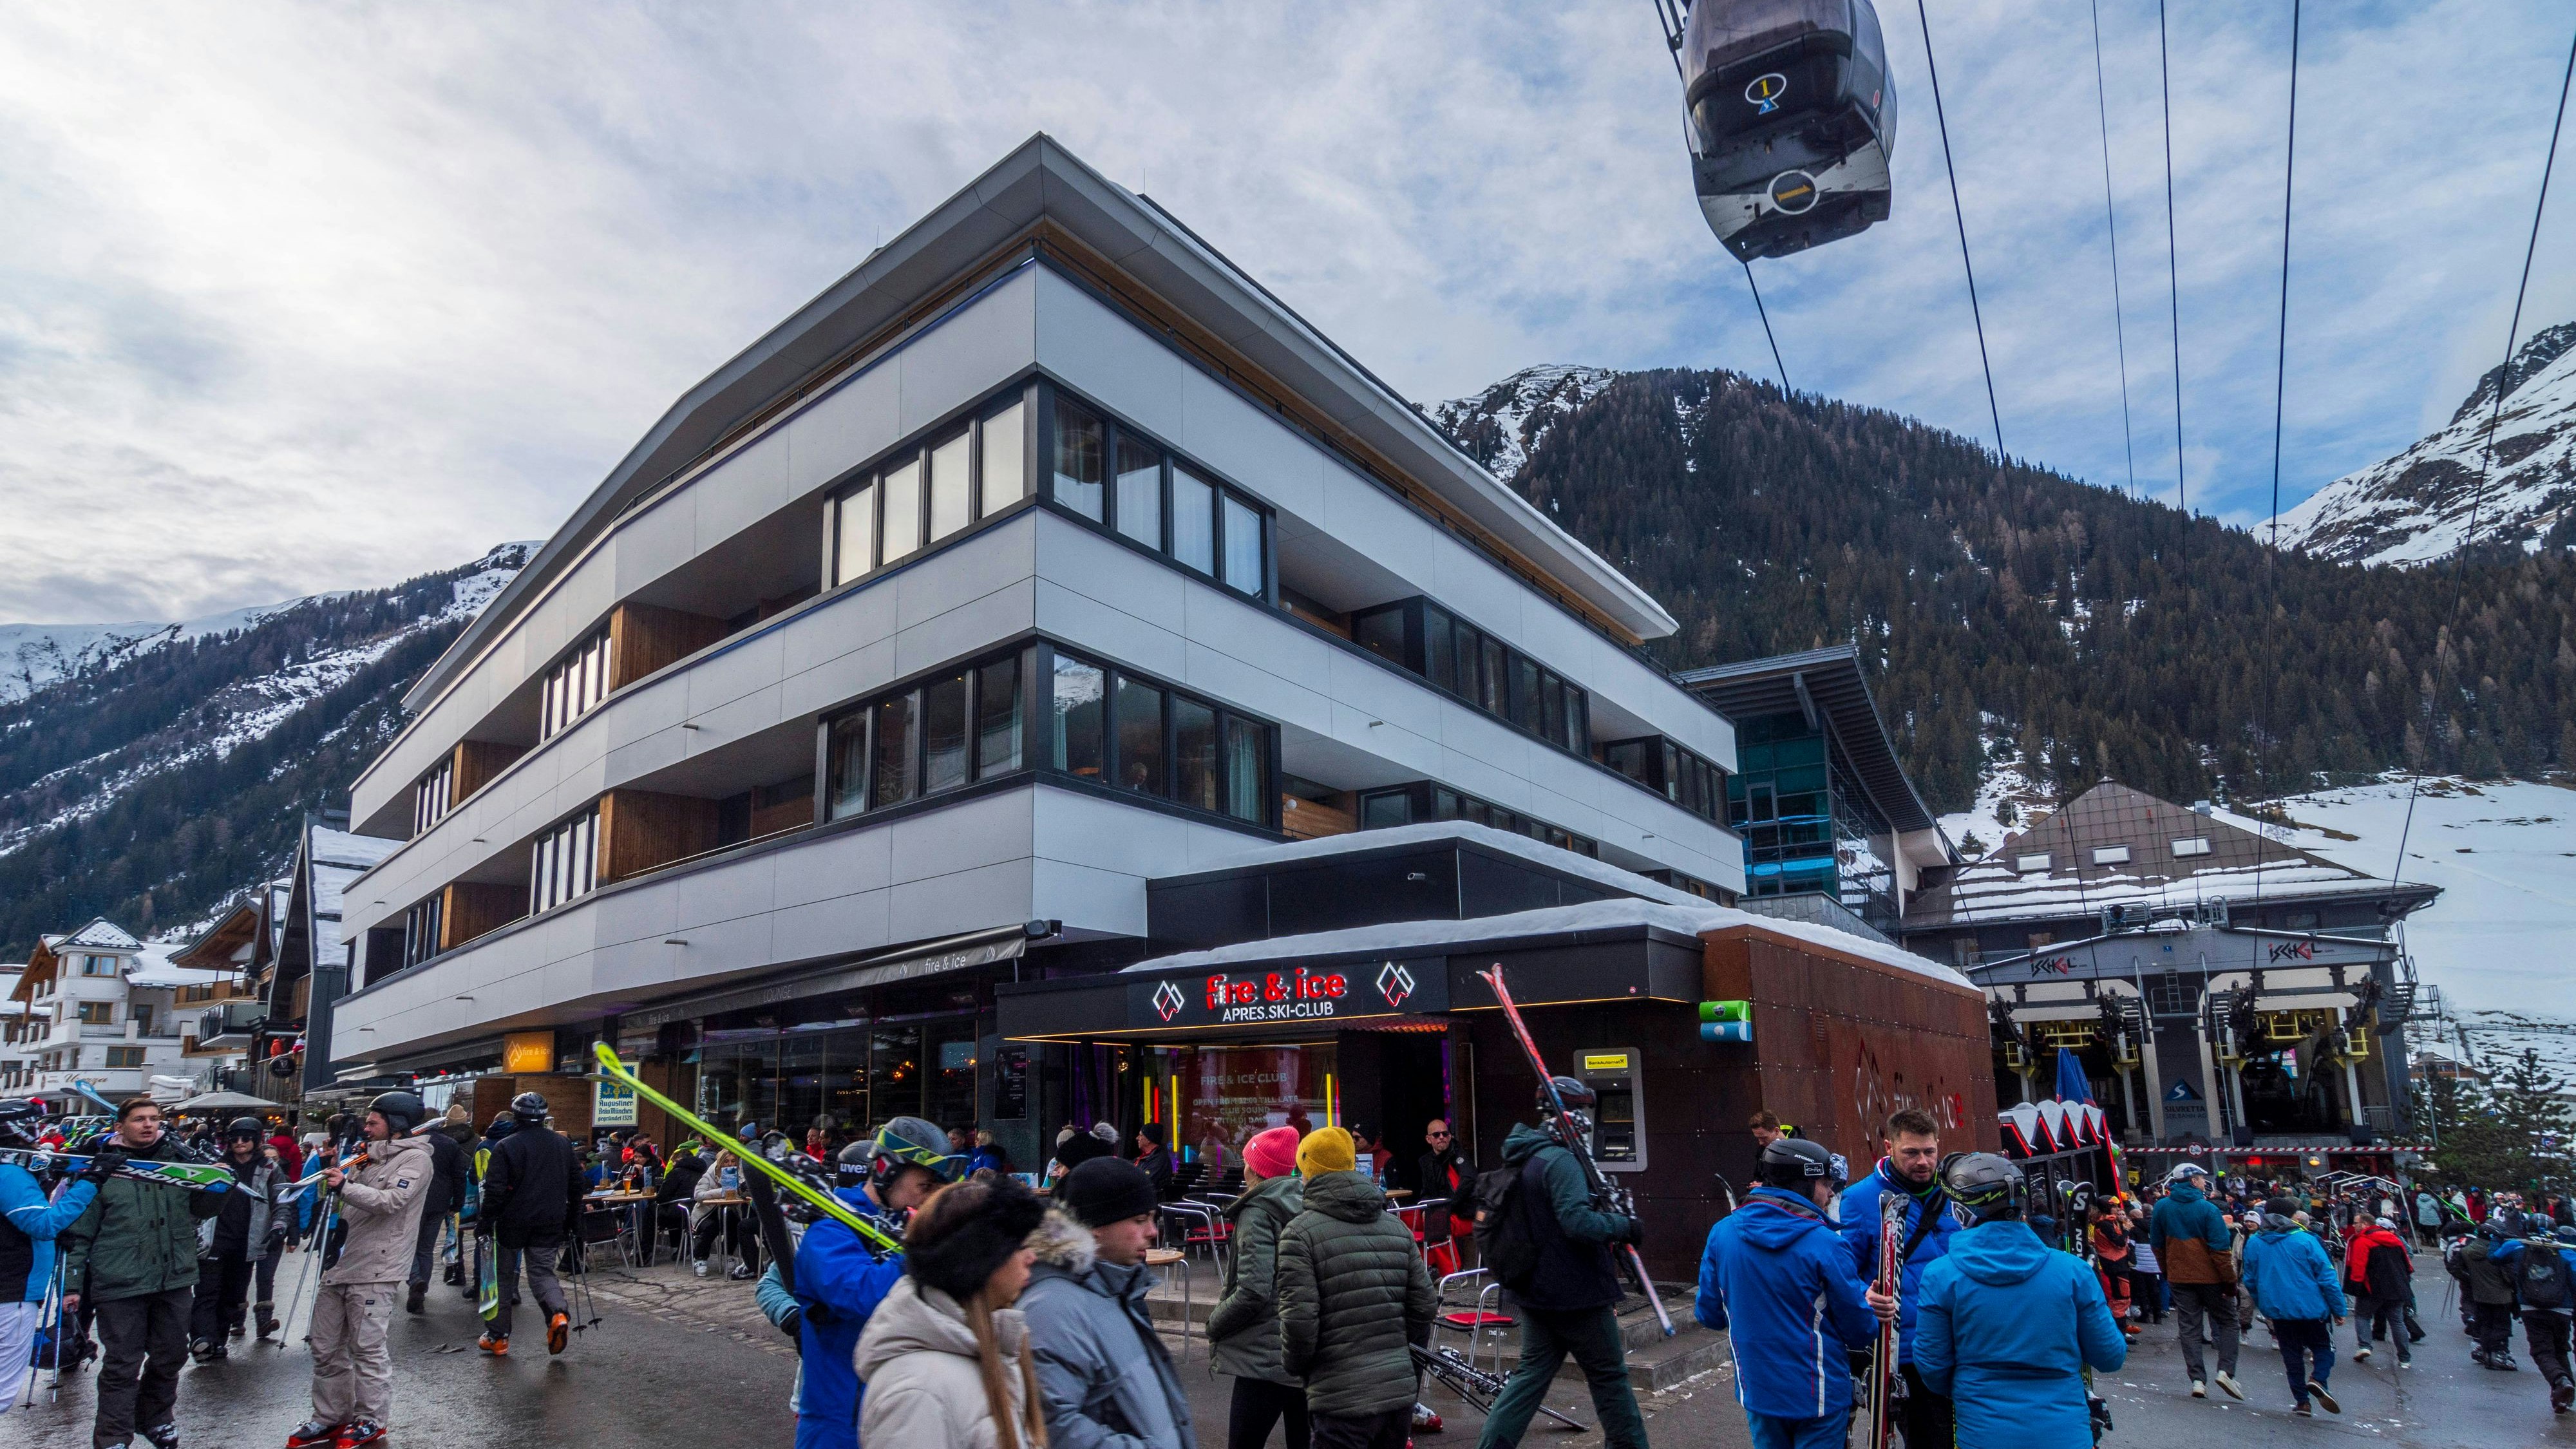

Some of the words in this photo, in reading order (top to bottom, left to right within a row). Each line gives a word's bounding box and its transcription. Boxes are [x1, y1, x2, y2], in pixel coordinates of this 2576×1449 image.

[1760, 79, 1771, 98] 1
[925, 957, 940, 973] fire
[942, 956, 949, 969] &
[951, 953, 967, 968] ice
[763, 985, 793, 1003] LOUNGE
[1206, 974, 1256, 1010] fire
[1264, 972, 1288, 1001] &
[1296, 967, 1347, 998] ice
[1222, 1002, 1334, 1022] APRES.SKI-CLUB
[522, 1047, 533, 1056] fire
[1200, 1075, 1226, 1086] FIRE
[1227, 1075, 1234, 1084] &
[1237, 1074, 1255, 1084] ICE
[1258, 1072, 1288, 1083] CLUB
[1216, 1097, 1238, 1105] FROM
[1278, 1095, 1299, 1103] LATE
[1238, 1117, 1247, 1125] DJ
[1794, 1154, 1815, 1163] ATOMIC
[115, 1164, 208, 1190] ORDICA
[1892, 1216, 1906, 1332] BLIZZARD
